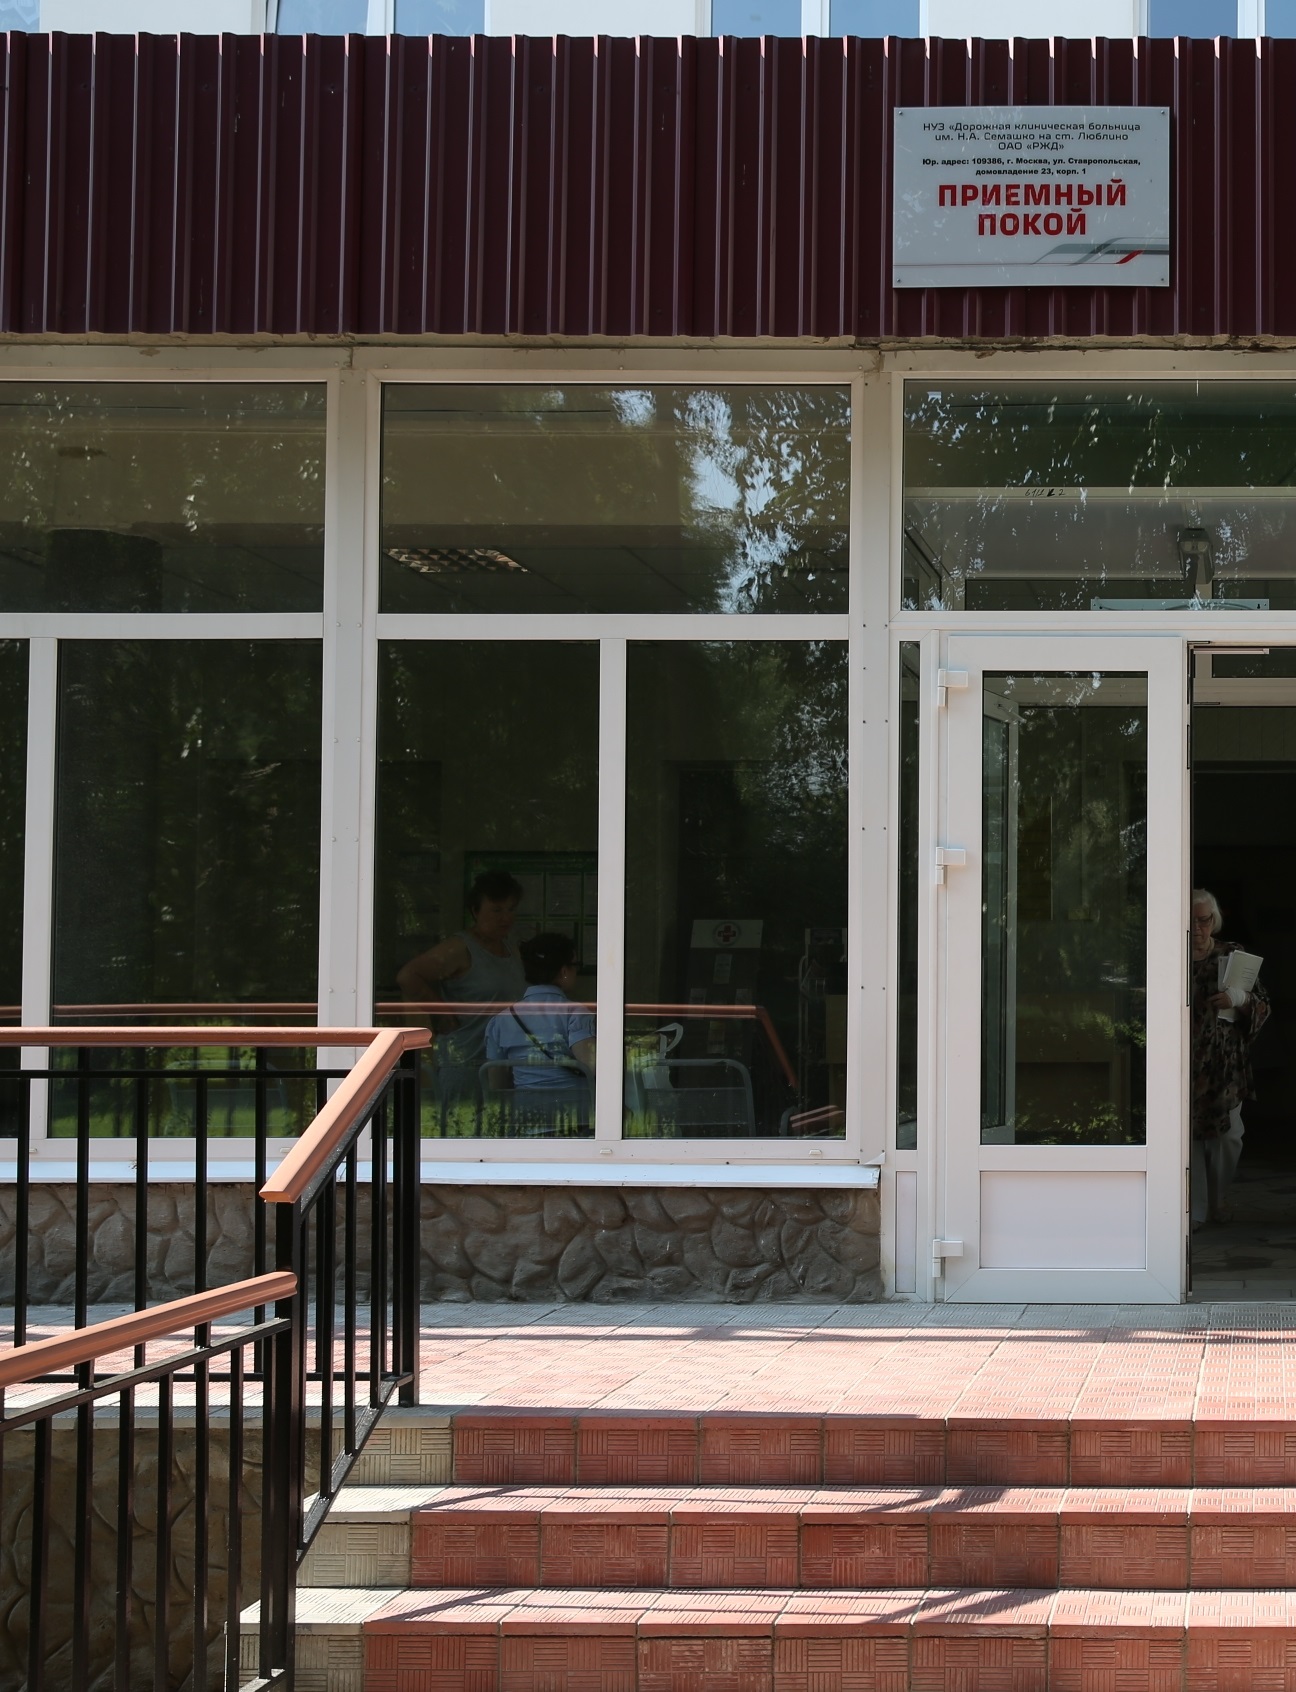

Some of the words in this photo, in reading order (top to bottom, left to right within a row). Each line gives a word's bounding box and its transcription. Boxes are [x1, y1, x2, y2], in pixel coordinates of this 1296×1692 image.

[923, 122, 945, 132] НУЗ
[948, 122, 1011, 133] «Дорожная
[1014, 123, 1085, 131] клиническая
[1088, 122, 1141, 132] больница
[957, 132, 980, 141] Н.А.
[983, 131, 1036, 141] Семашко
[1038, 133, 1052, 141] на
[1054, 133, 1074, 141] ст.
[1077, 131, 1129, 141] Люблино
[998, 141, 1023, 151] ОАО
[1026, 141, 1065, 152] «РЖД»
[922, 158, 939, 167] Юр.
[940, 159, 970, 167] адрес:
[971, 157, 1005, 166] 109386,
[1015, 157, 1051, 166] Москва,
[1052, 158, 1066, 166] ул.
[1067, 157, 1141, 166] Ставропольская,
[1040, 167, 1054, 176] 23,
[939, 179, 1126, 206] ПРИЕМНЫЙ
[979, 208, 1086, 236] ПОКОЙ
